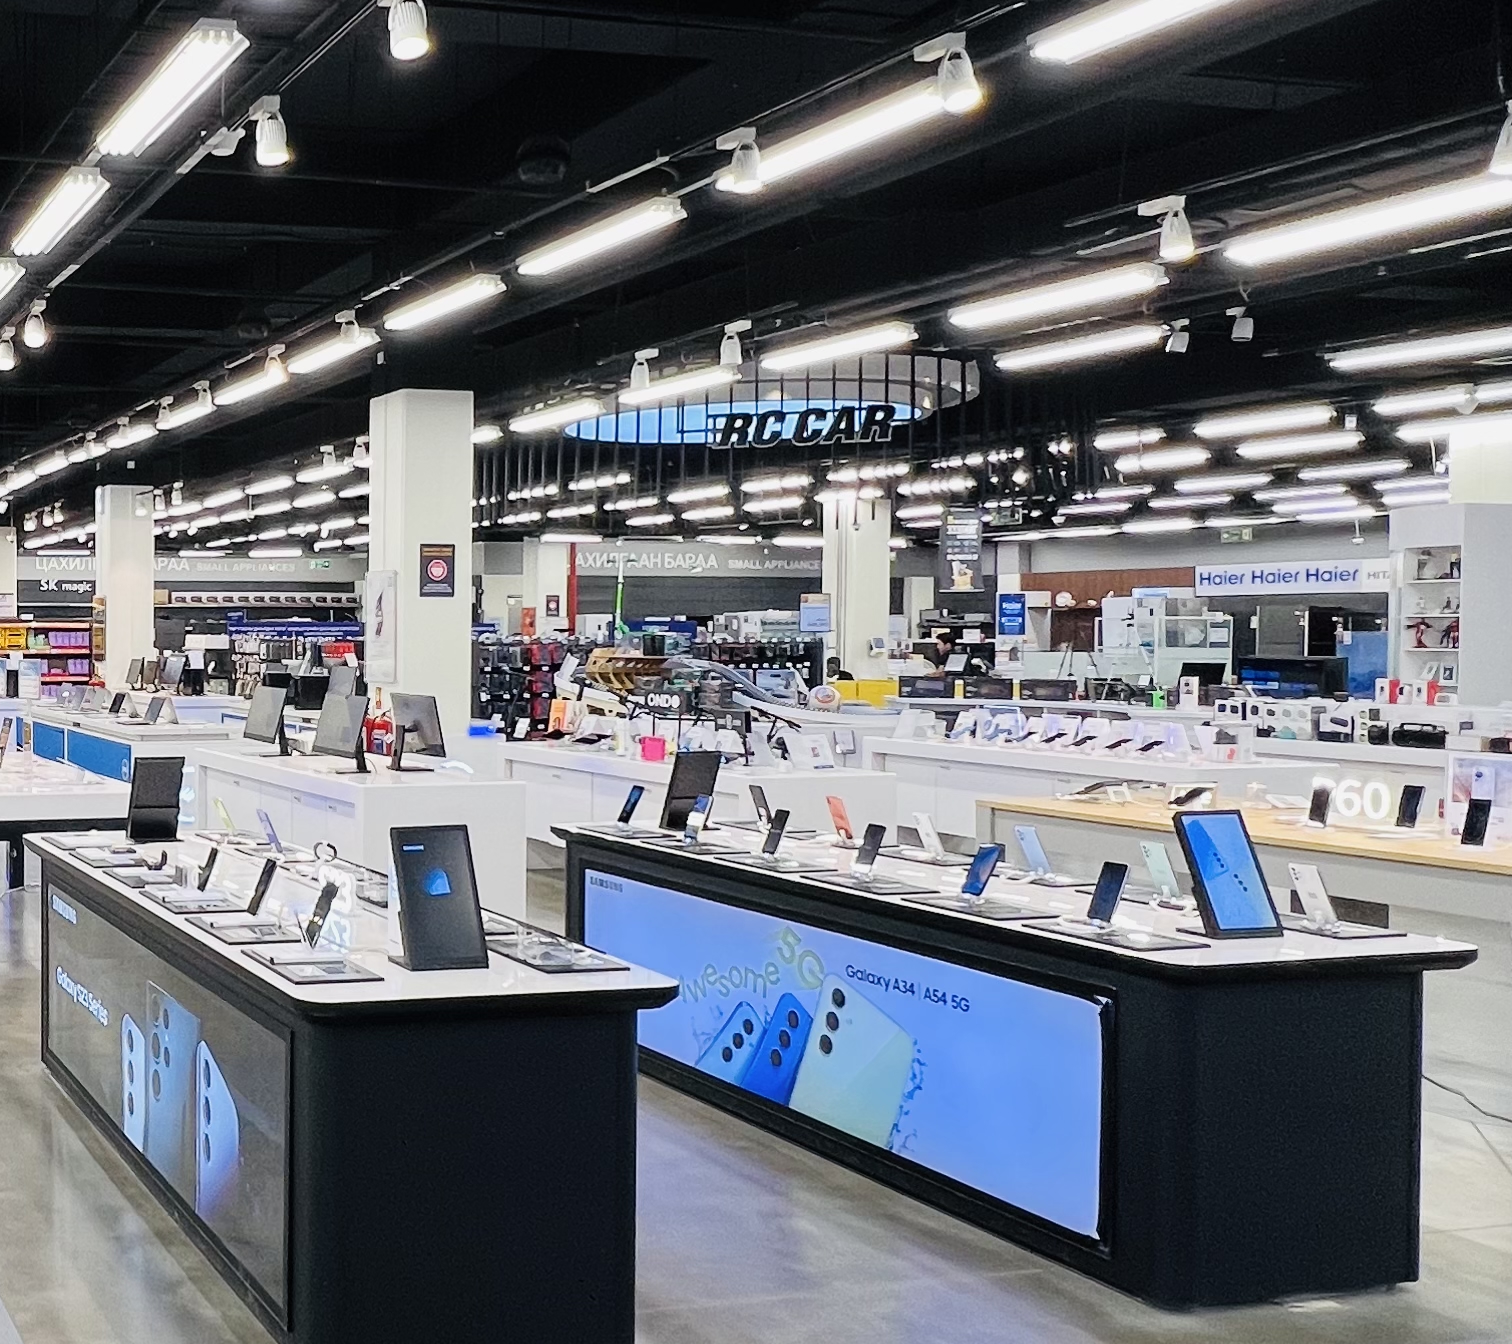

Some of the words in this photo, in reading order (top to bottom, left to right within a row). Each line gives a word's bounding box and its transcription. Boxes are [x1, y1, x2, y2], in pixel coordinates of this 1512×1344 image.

[710, 410, 786, 449] RC
[791, 404, 896, 446] CAR
[196, 562, 229, 572] SMALL
[728, 559, 762, 570] SMALL
[1199, 570, 1245, 586] Haier
[1251, 568, 1300, 584] Haier
[1306, 565, 1359, 582] Haier
[40, 578, 58, 592] SK
[61, 581, 92, 594] magic
[590, 875, 623, 893] SAMSUNG
[845, 964, 890, 992] Galaxy
[892, 978, 915, 996] A34
[923, 987, 947, 1006] A54
[951, 994, 970, 1012] 5G
